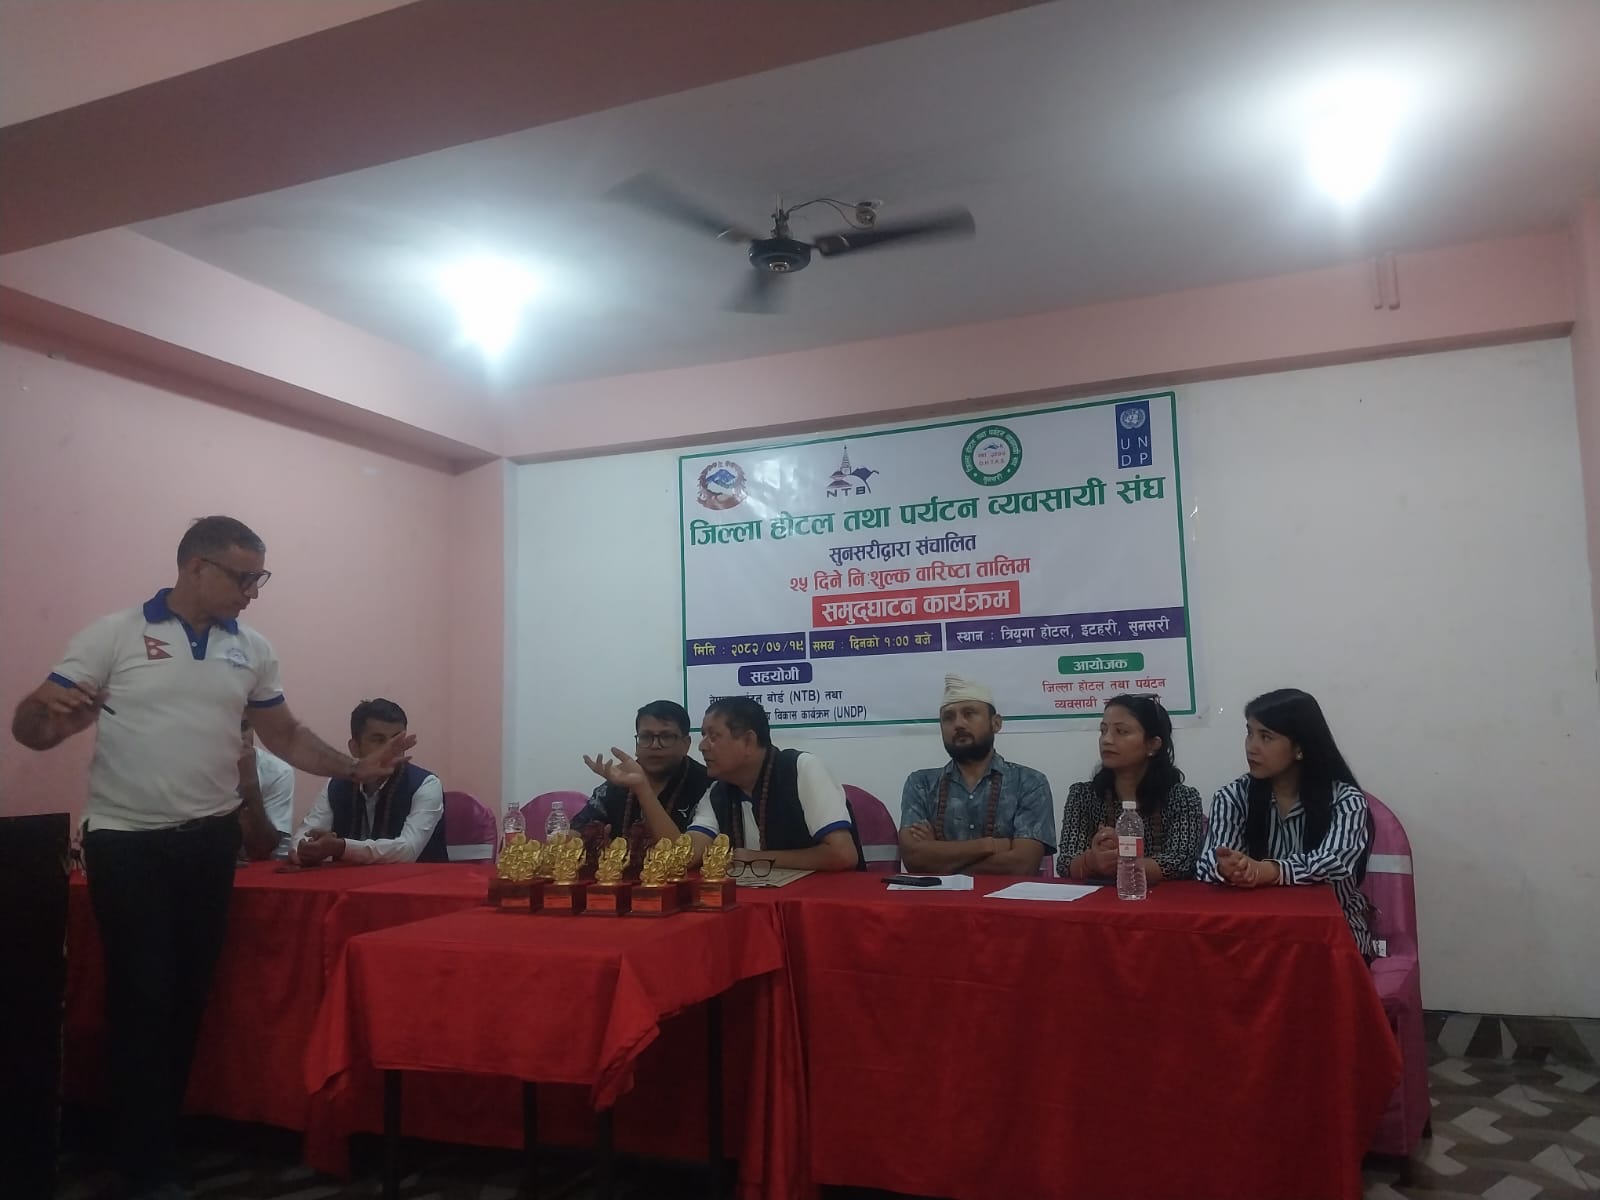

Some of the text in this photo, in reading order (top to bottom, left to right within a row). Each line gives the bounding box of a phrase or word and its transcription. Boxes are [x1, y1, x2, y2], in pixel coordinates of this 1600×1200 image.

[827, 485, 867, 498] NTB
[690, 474, 1167, 546] जिल्ला होटल तथा पर्यटन व्यवसायी संघ
[828, 531, 977, 567] सुनसरीद्वारा संचालित
[789, 576, 808, 593] २५
[814, 569, 843, 591] दिने
[976, 554, 1031, 578] तालिम
[923, 587, 1012, 613] कार्यक्रम
[956, 629, 984, 644] स्थान
[1000, 623, 1035, 644] त्रियुगा
[1040, 622, 1075, 640] होटल,
[1080, 618, 1122, 637] इटहरी,
[1127, 615, 1171, 637] सुनसरी
[694, 642, 717, 656] मिति
[812, 639, 835, 653] समय
[849, 633, 880, 649] दिनको
[1073, 655, 1129, 673] आयोजक
[750, 665, 801, 685] सहयोगी
[1042, 680, 1074, 694] जिल्ला
[1078, 679, 1105, 692] होटल
[1135, 675, 1168, 689] पर्यटन
[789, 688, 821, 705] (NTB)
[824, 689, 844, 700] तथा
[1054, 695, 1098, 710] व्यवसायी
[774, 708, 798, 721] विकास
[801, 706, 831, 720] कार्यक्रम
[833, 705, 868, 721] (UNDP)
